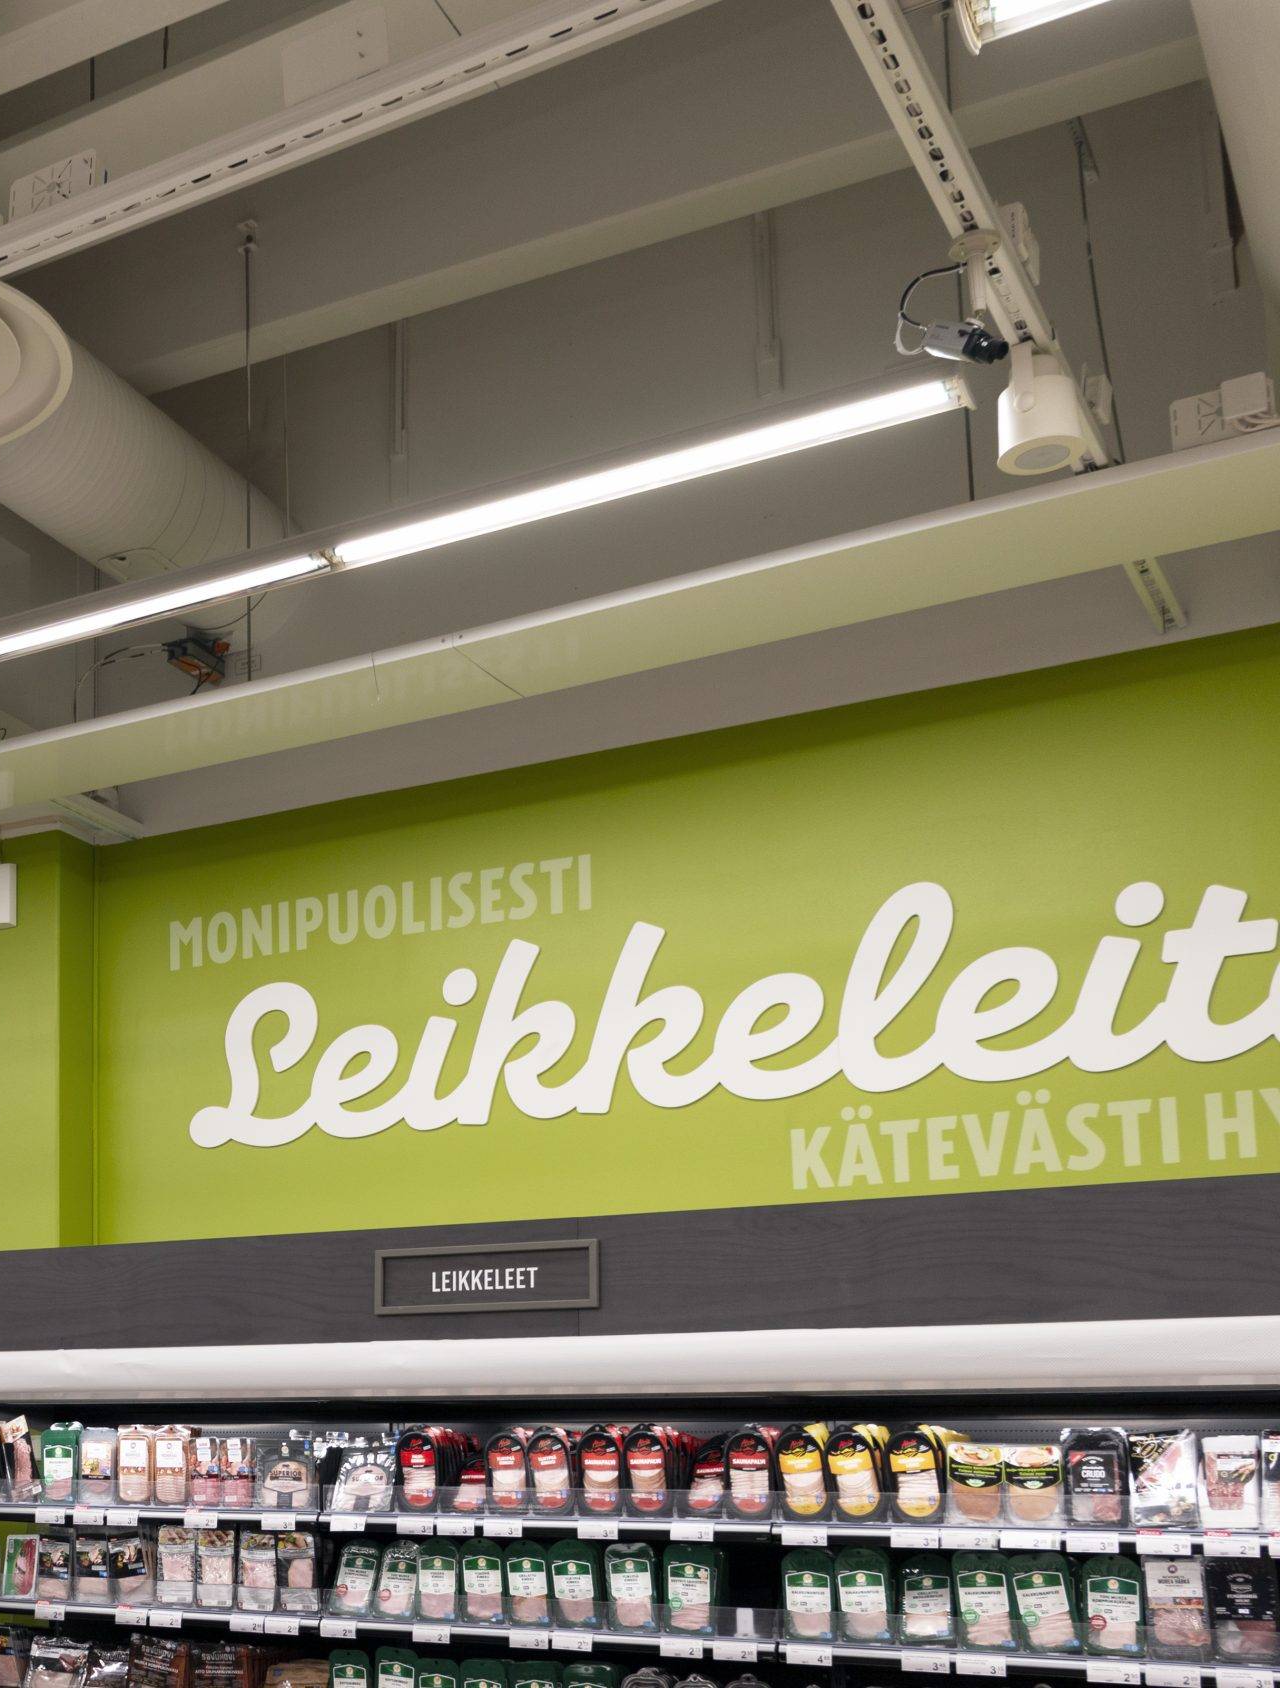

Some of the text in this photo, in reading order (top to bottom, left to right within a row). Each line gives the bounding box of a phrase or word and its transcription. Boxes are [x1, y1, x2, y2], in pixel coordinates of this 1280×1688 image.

[168, 854, 593, 971] MONIPUOLISESTI
[189, 881, 1280, 1148] Leikkeleit
[790, 1089, 1180, 1190] KÄTEVÄSTI
[431, 1267, 539, 1292] LEIKKELEET
